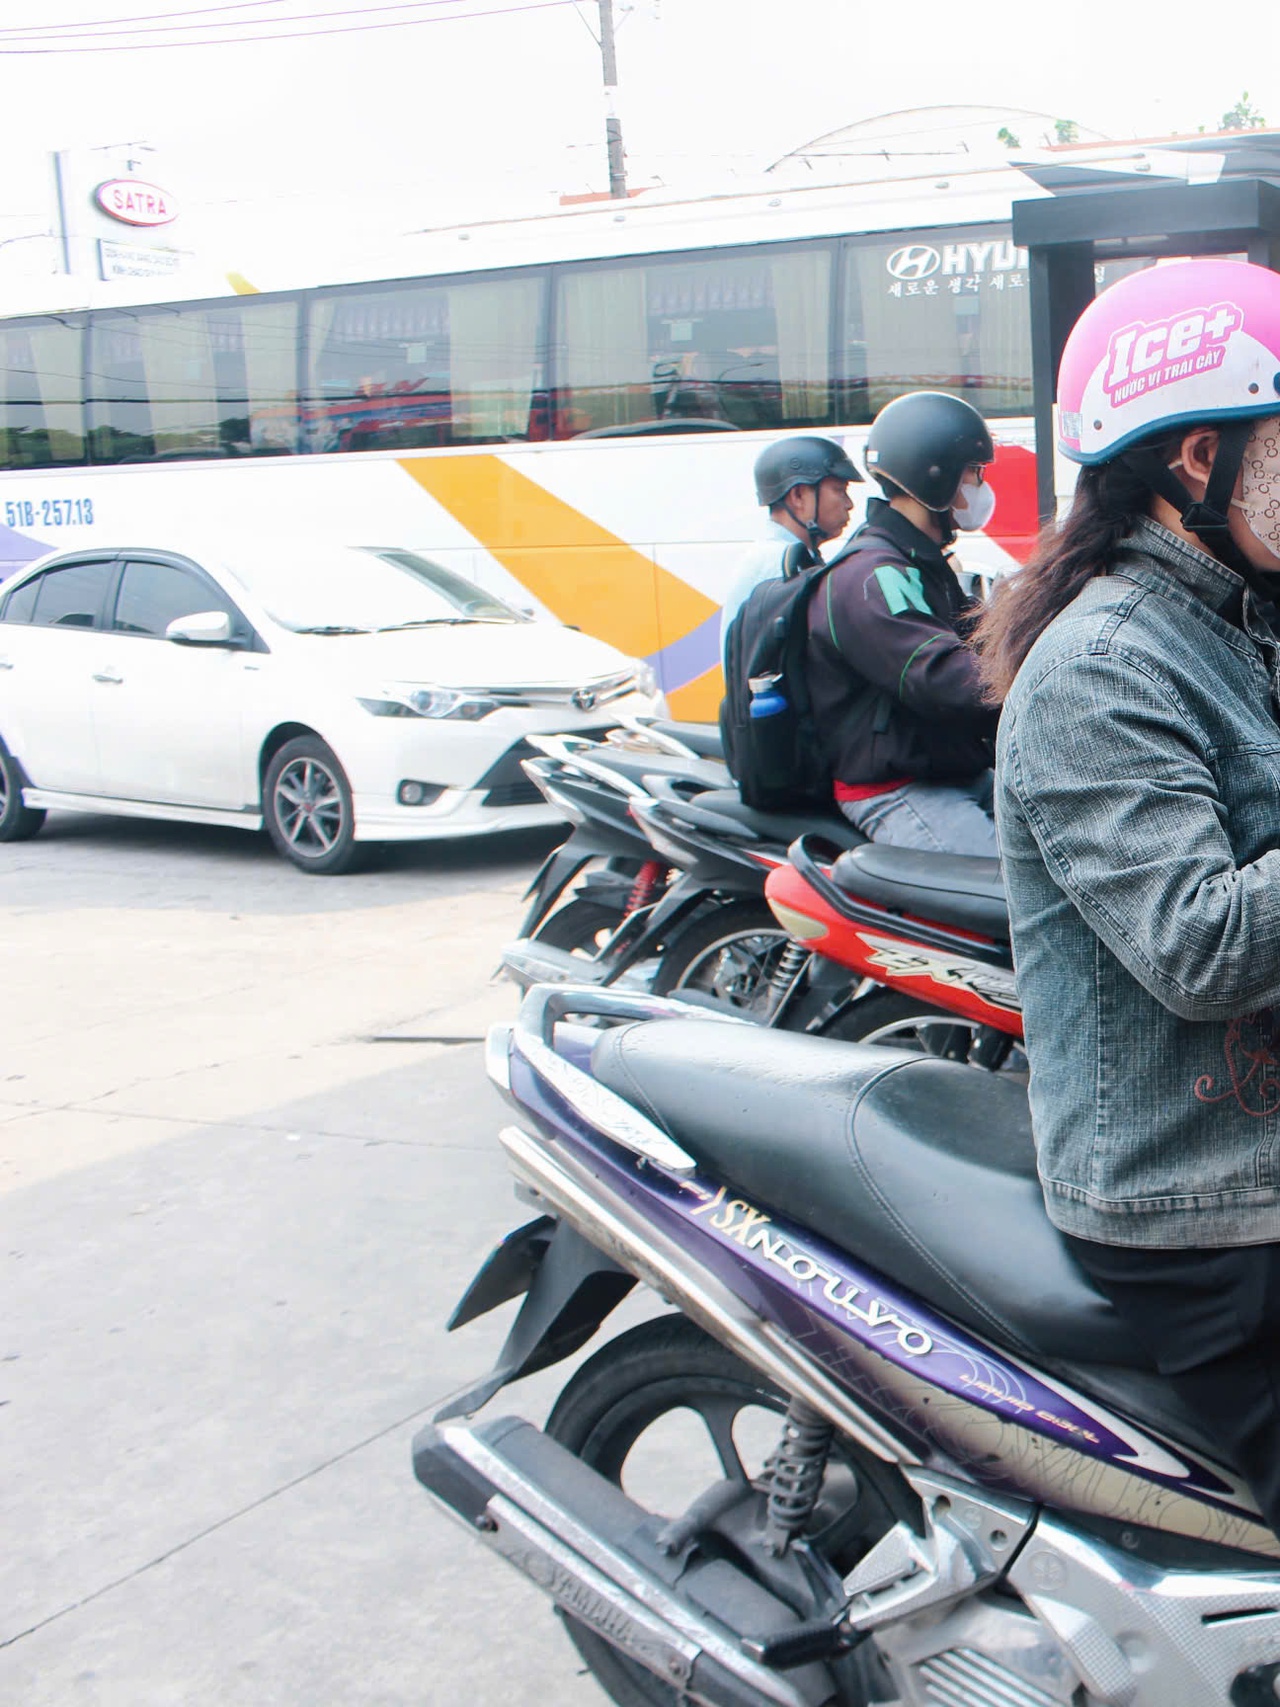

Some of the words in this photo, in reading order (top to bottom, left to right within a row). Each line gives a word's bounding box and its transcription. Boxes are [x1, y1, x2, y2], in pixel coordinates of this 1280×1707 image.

[113, 189, 167, 214] SATRA
[887, 280, 940, 298] 새로운
[989, 272, 1029, 292] 새로
[5, 498, 95, 528] 51B-257.13
